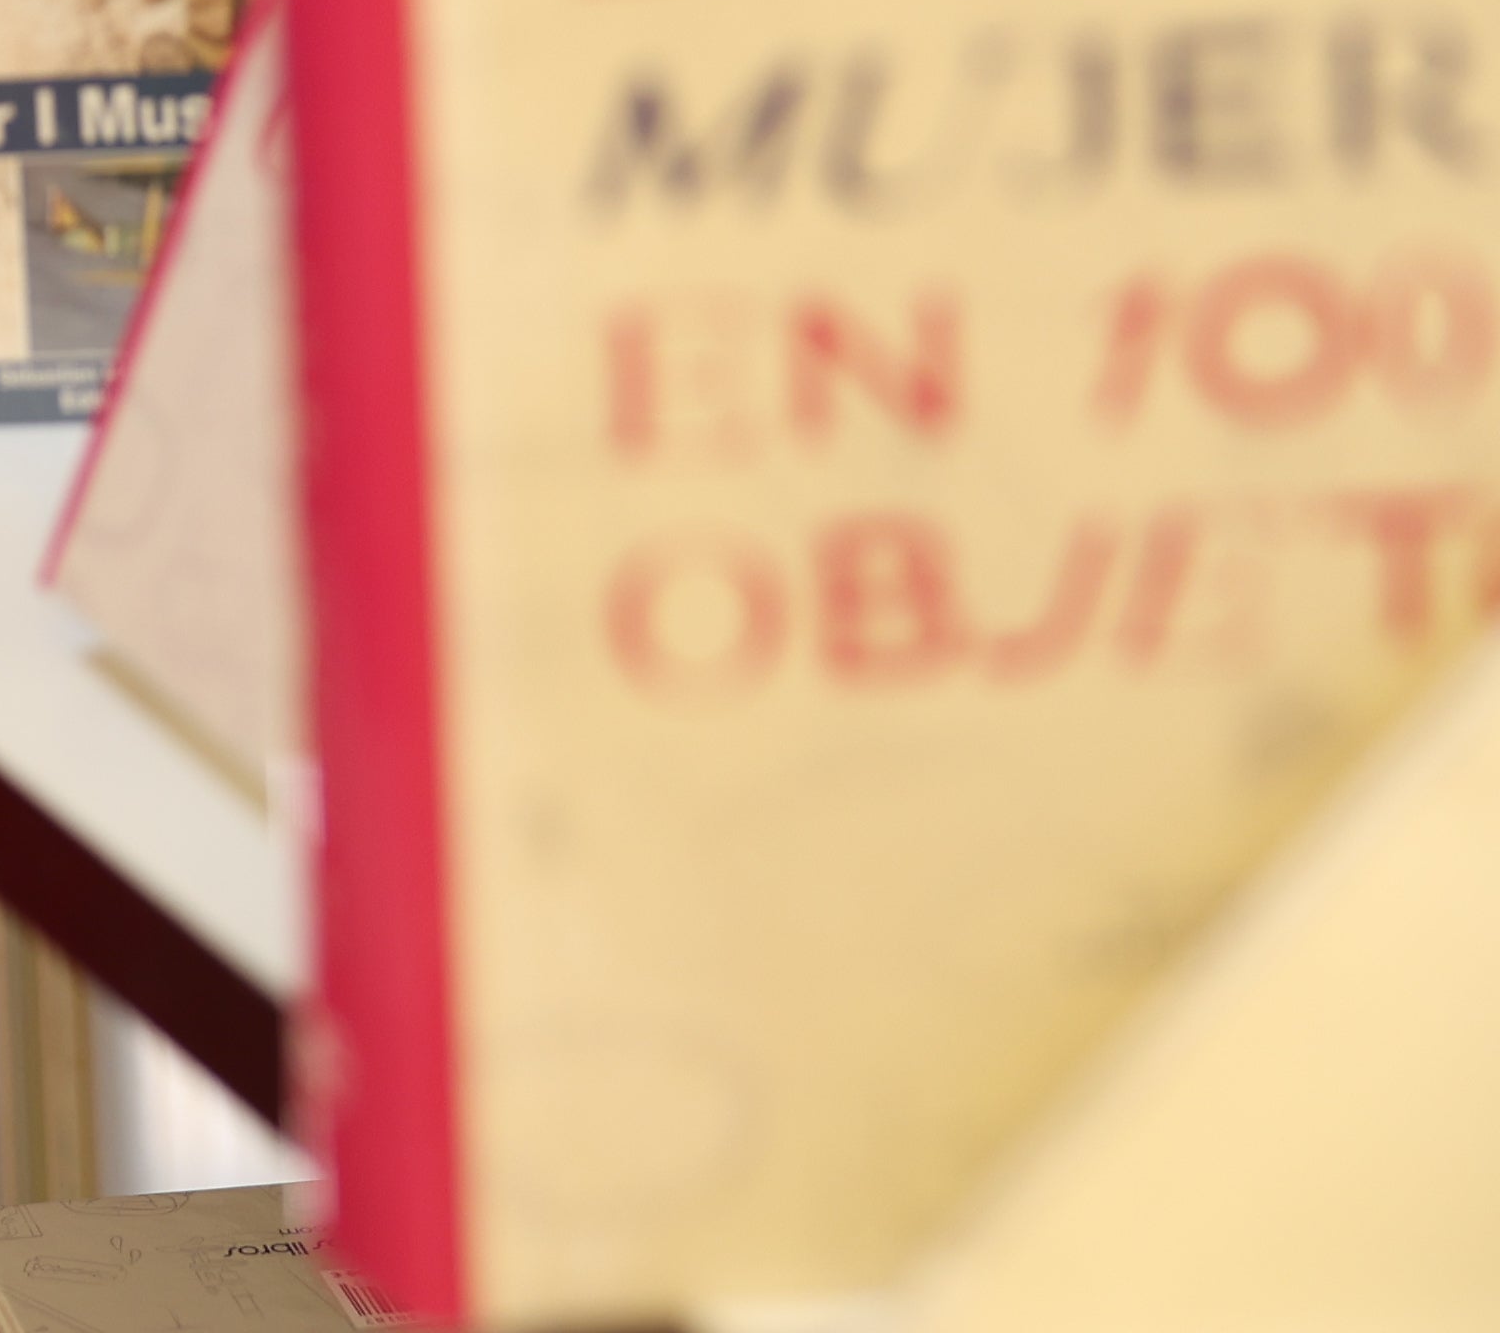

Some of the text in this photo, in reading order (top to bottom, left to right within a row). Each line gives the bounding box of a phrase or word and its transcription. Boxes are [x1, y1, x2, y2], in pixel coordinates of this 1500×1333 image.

[35, 86, 58, 148] I
[582, 18, 1490, 218] MUJER
[605, 283, 962, 465] EN
[224, 1240, 310, 1259] libros
